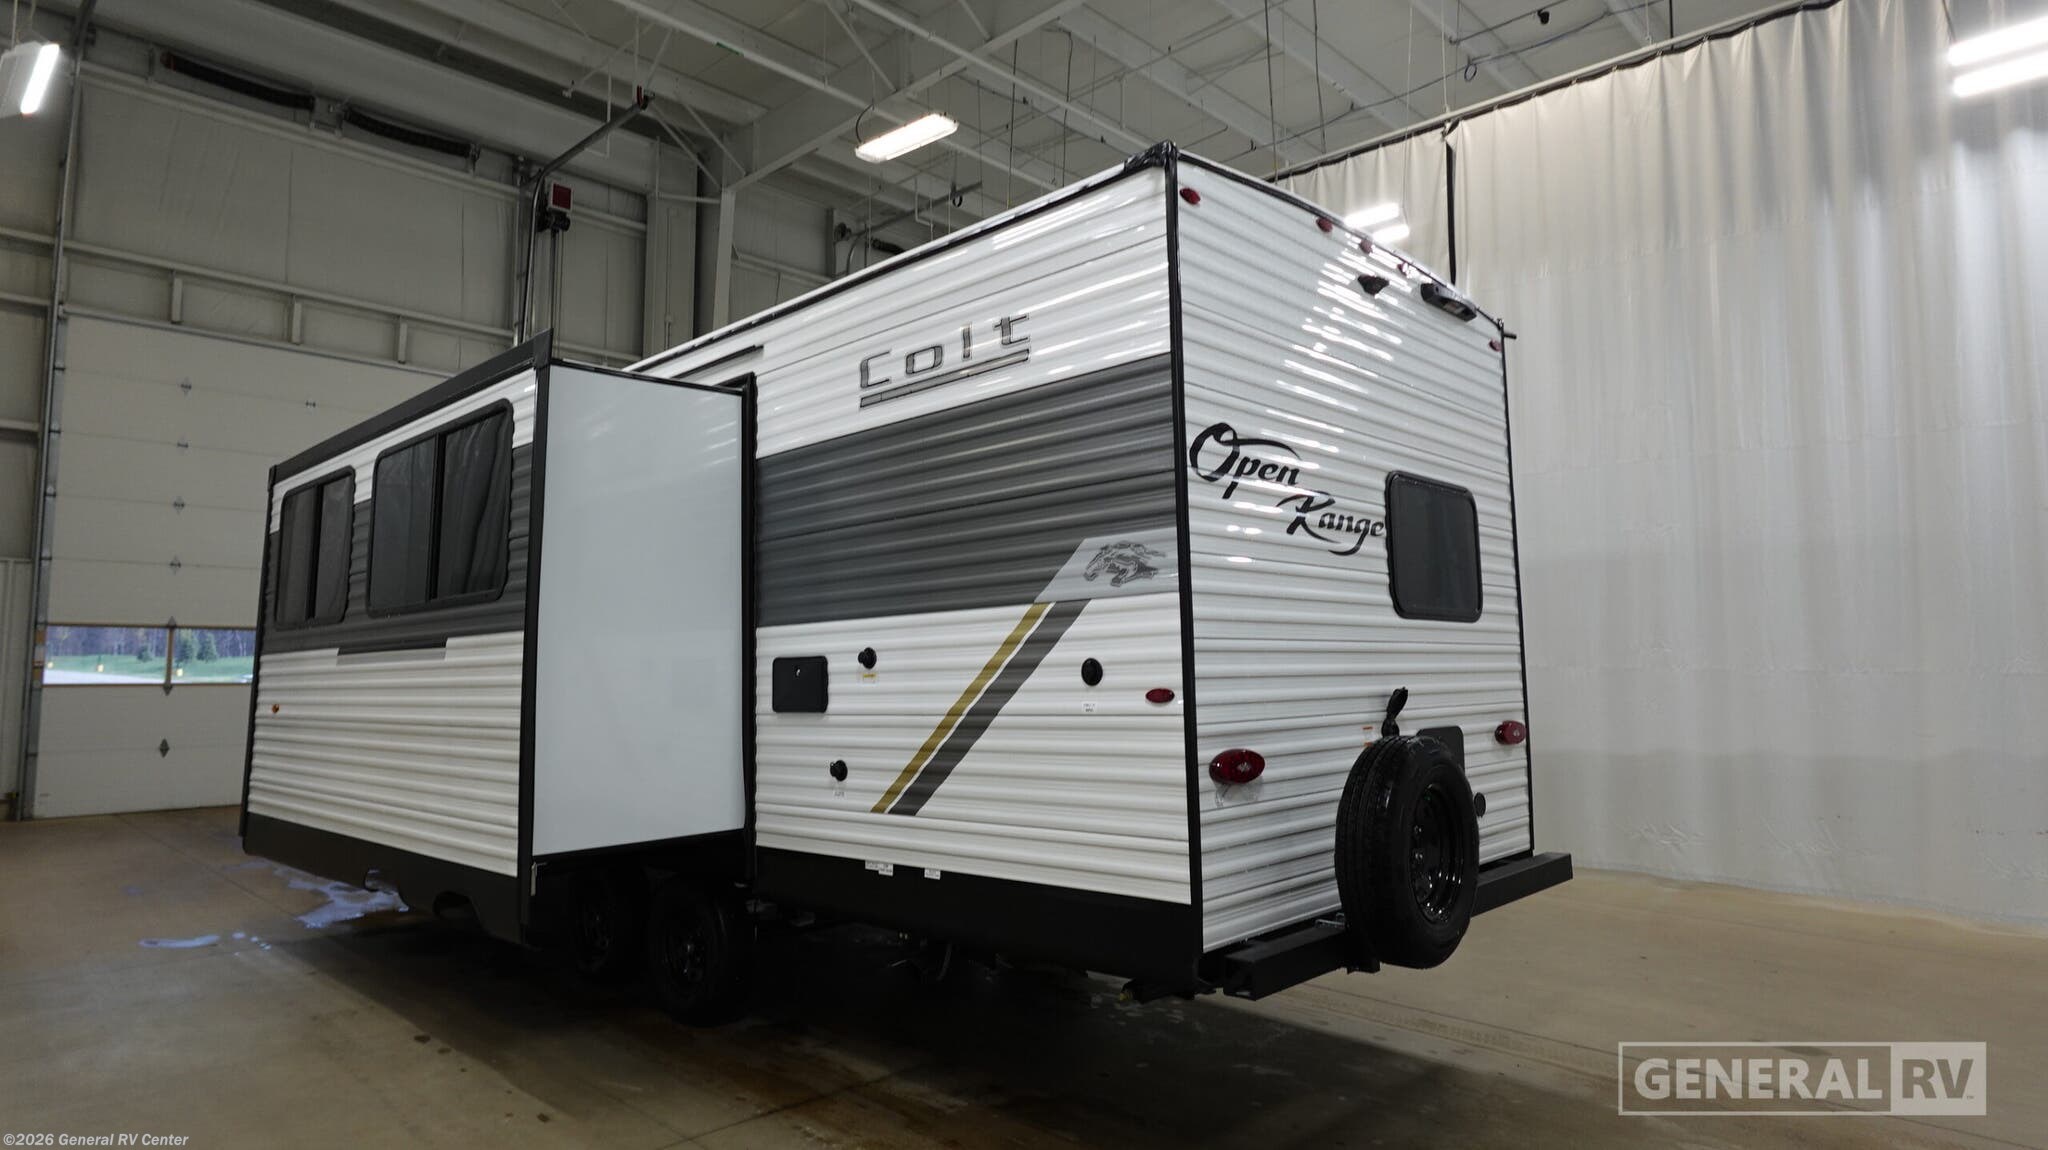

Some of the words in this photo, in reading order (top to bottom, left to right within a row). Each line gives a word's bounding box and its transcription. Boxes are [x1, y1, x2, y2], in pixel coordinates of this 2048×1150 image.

[860, 313, 1029, 389] Colt
[1189, 422, 1301, 499] Open
[1275, 490, 1385, 556] Range
